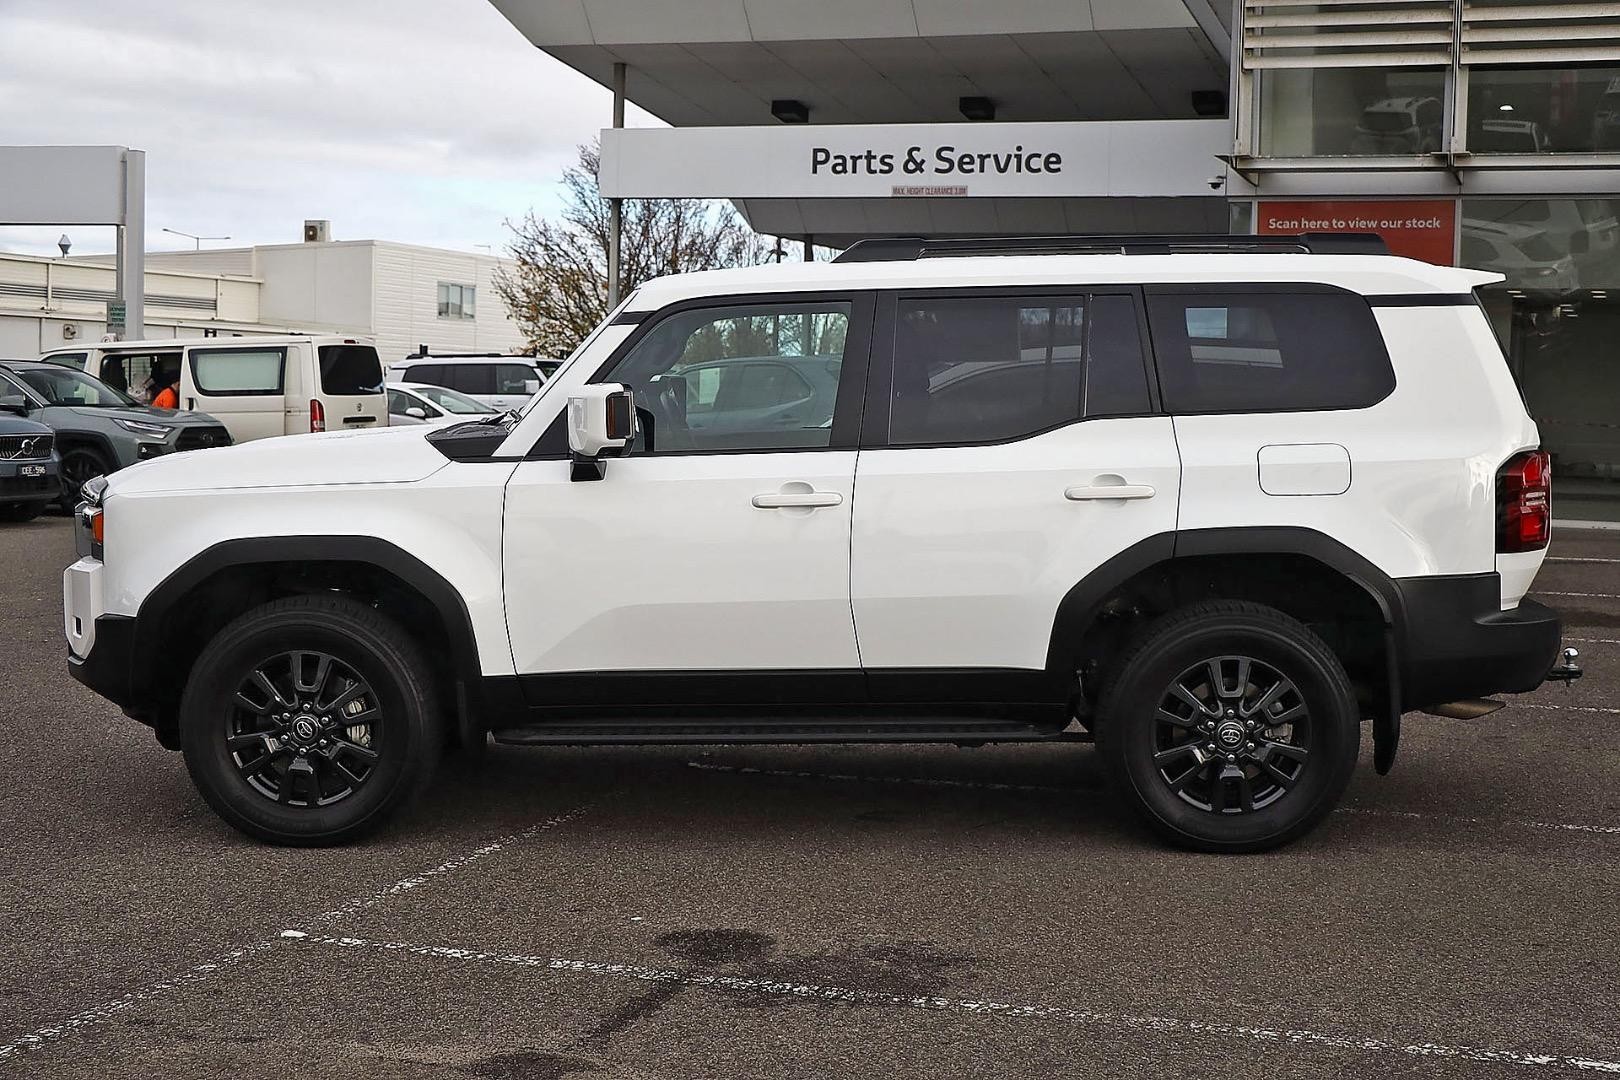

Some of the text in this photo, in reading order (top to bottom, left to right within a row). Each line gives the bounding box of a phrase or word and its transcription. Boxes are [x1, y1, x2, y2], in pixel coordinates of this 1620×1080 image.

[812, 145, 1062, 175] Parts & Service
[907, 187, 924, 196] HEIGHT
[925, 187, 953, 196] CLEARANCE
[1268, 217, 1441, 229] Scan here to view our stock
